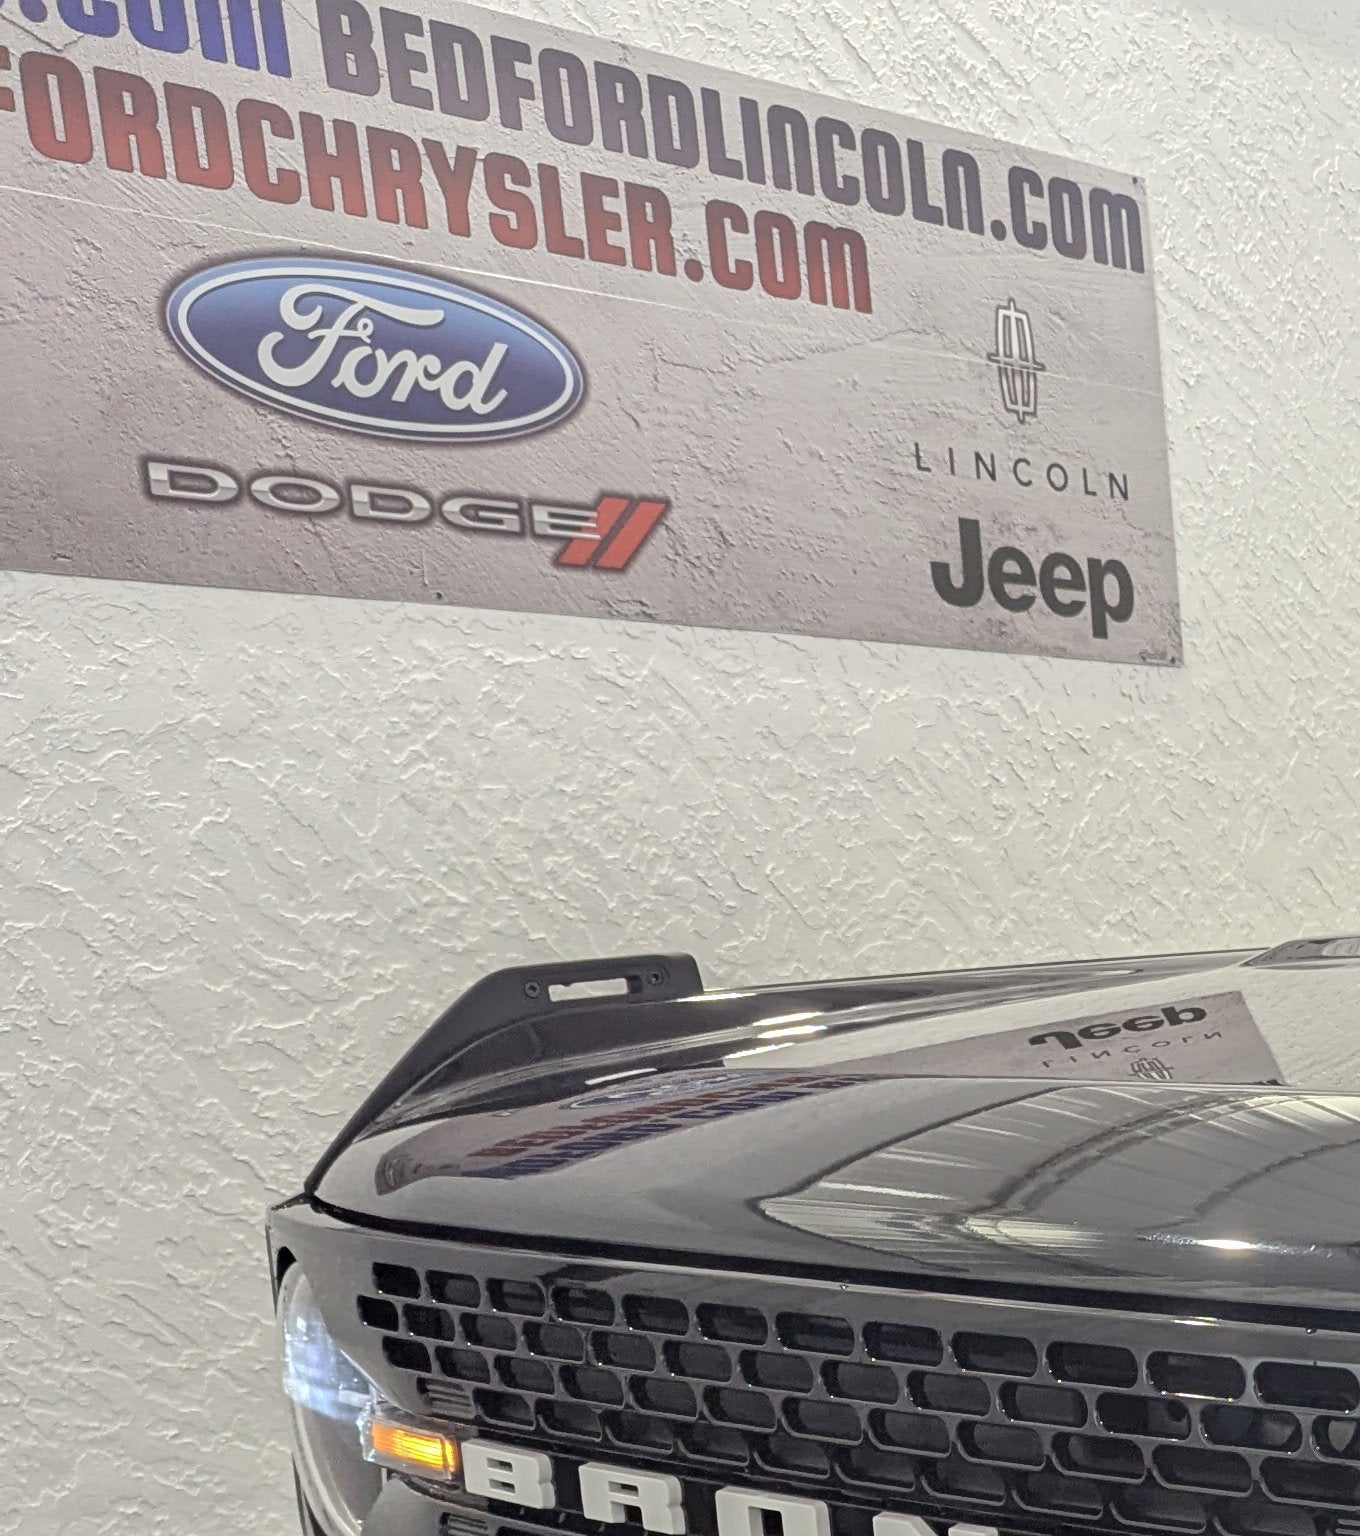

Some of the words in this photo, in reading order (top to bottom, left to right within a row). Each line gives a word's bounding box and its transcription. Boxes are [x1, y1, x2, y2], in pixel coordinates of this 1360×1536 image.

[0, 44, 872, 314] ORDCHRYSLER.COM
[257, 283, 509, 416] Ford
[147, 462, 602, 541] DODGE
[914, 441, 1129, 501] LINCOLN
[929, 516, 1135, 640] Jeep
